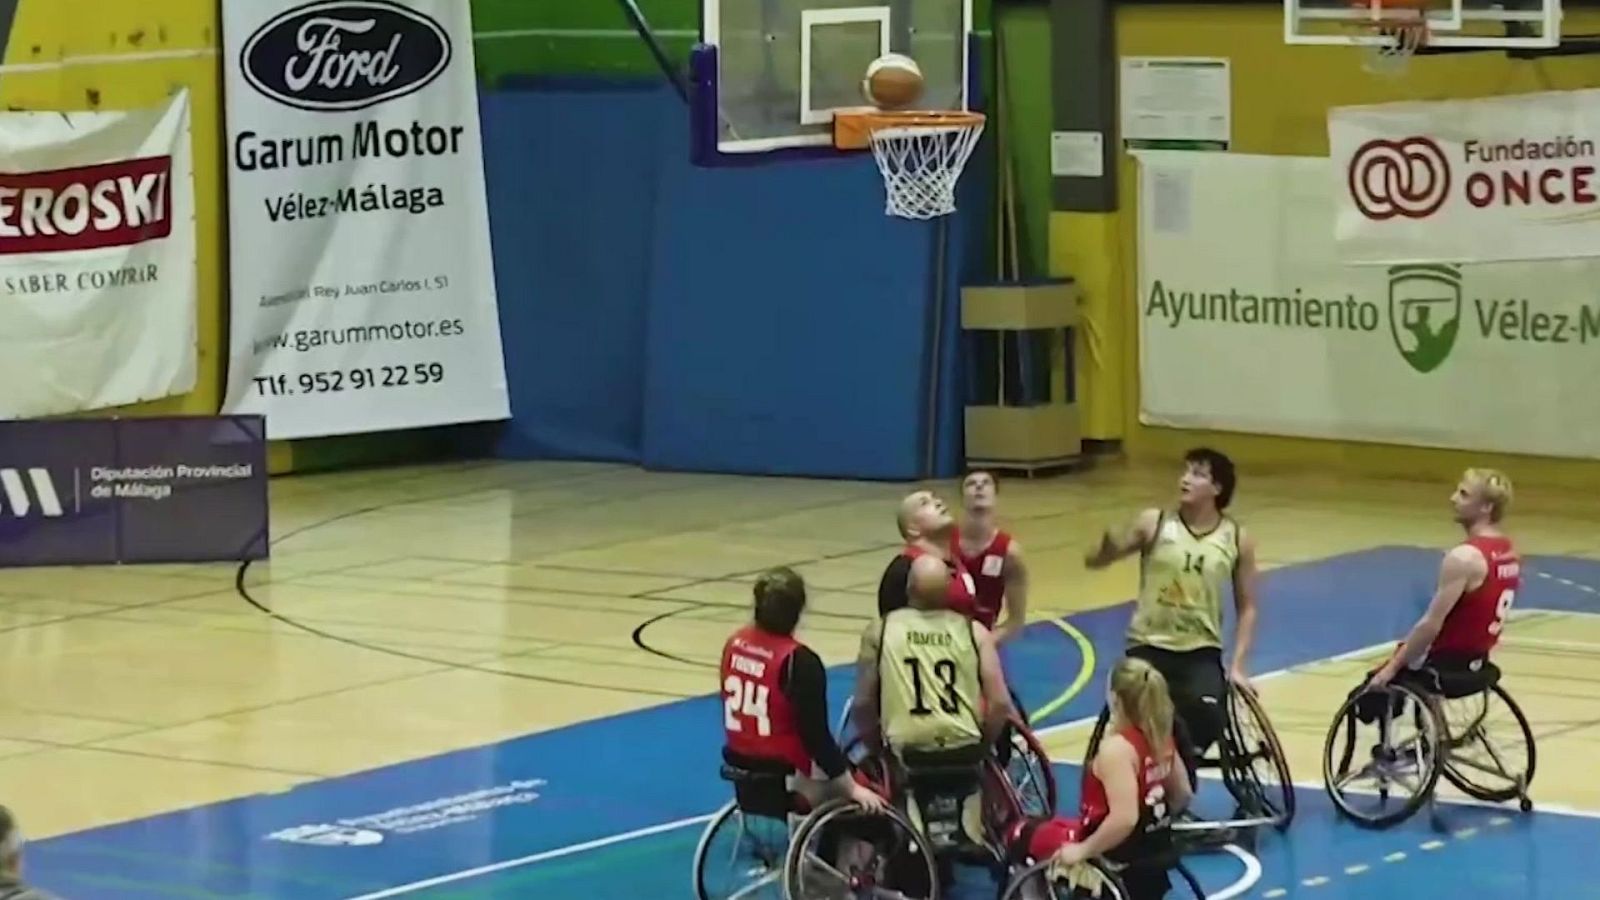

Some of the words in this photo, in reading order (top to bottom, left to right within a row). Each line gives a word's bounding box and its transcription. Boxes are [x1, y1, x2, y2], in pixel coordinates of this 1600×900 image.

[284, 17, 402, 91] Ford
[235, 131, 343, 171] Garum
[353, 120, 464, 159] Motor
[1464, 136, 1595, 163] Fundación
[0, 172, 167, 237] EROSKI
[265, 184, 444, 222] Vélez-Málaga
[1465, 167, 1597, 208] ONCE
[5, 274, 70, 295] SABER
[313, 286, 340, 299] Rey
[344, 284, 377, 295] Juan
[379, 279, 421, 293] Carlos
[1146, 279, 1379, 332] Ayuntamiento
[253, 318, 464, 355] w.garummotor.es
[252, 374, 294, 396] Tlf.
[299, 371, 343, 394] 952
[350, 368, 375, 390] 91
[381, 365, 408, 386] 22
[414, 362, 444, 384] 59
[91, 466, 174, 481] Diputación
[177, 463, 252, 478] Provincial
[91, 485, 111, 498] de
[115, 482, 171, 500] Málaga
[1183, 551, 1204, 575] 14
[1488, 588, 1515, 636] 9
[724, 674, 771, 736] 24
[904, 657, 960, 715] 13
